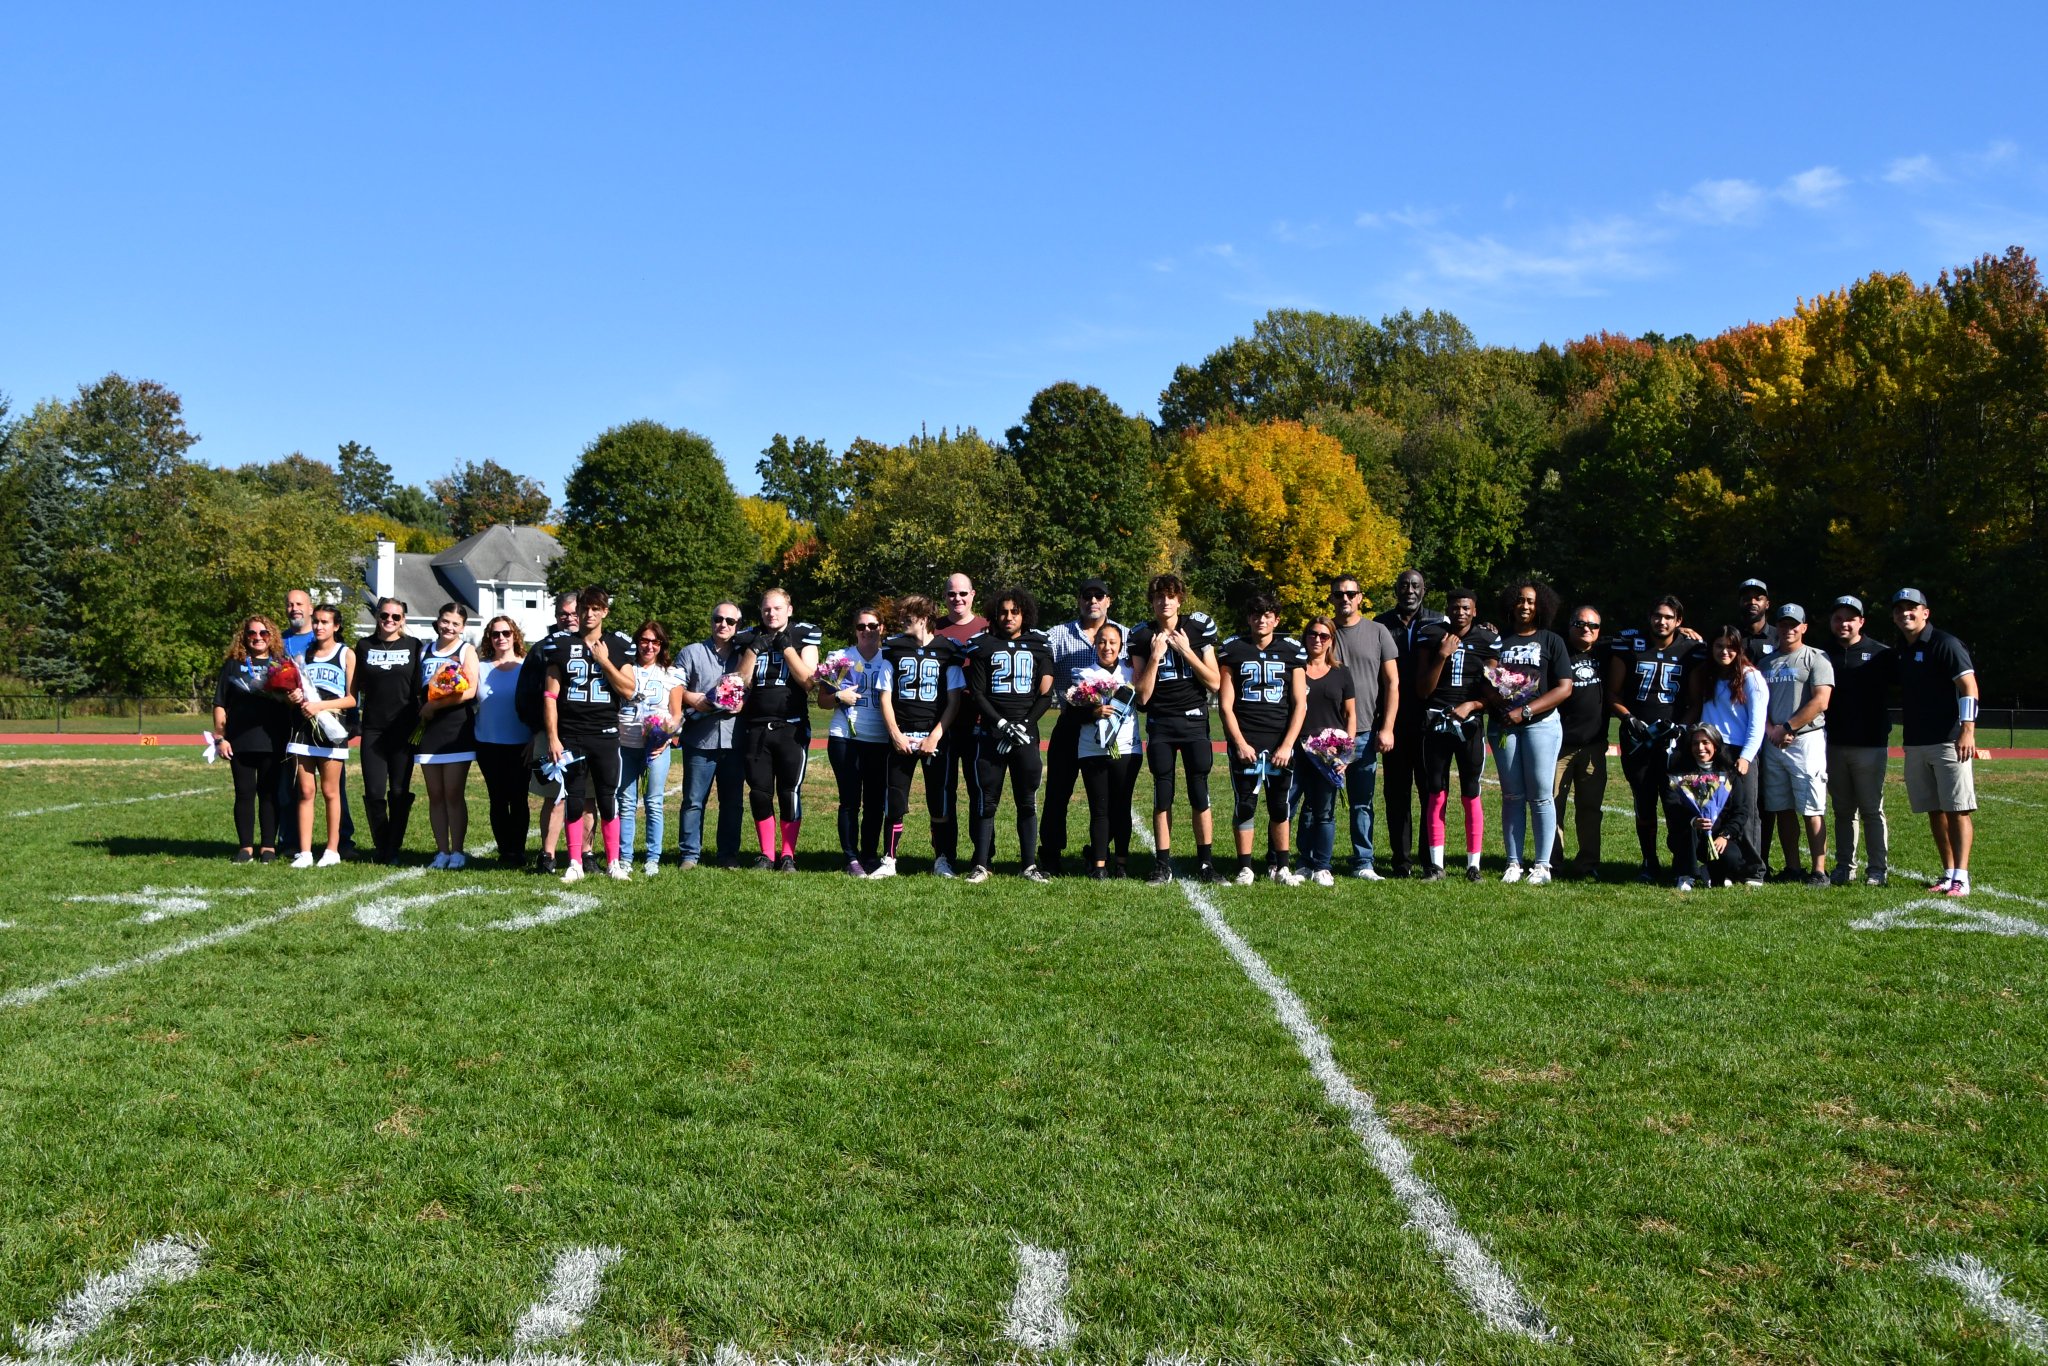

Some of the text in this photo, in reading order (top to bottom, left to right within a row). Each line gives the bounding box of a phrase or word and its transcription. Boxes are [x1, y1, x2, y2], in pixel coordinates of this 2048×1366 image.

[316, 667, 340, 685] NECK
[567, 659, 611, 703] 22
[898, 657, 940, 702] 28
[991, 651, 1034, 694] 20
[1240, 661, 1286, 703] 25
[1451, 649, 1465, 687] 1
[1635, 661, 1682, 704] 75
